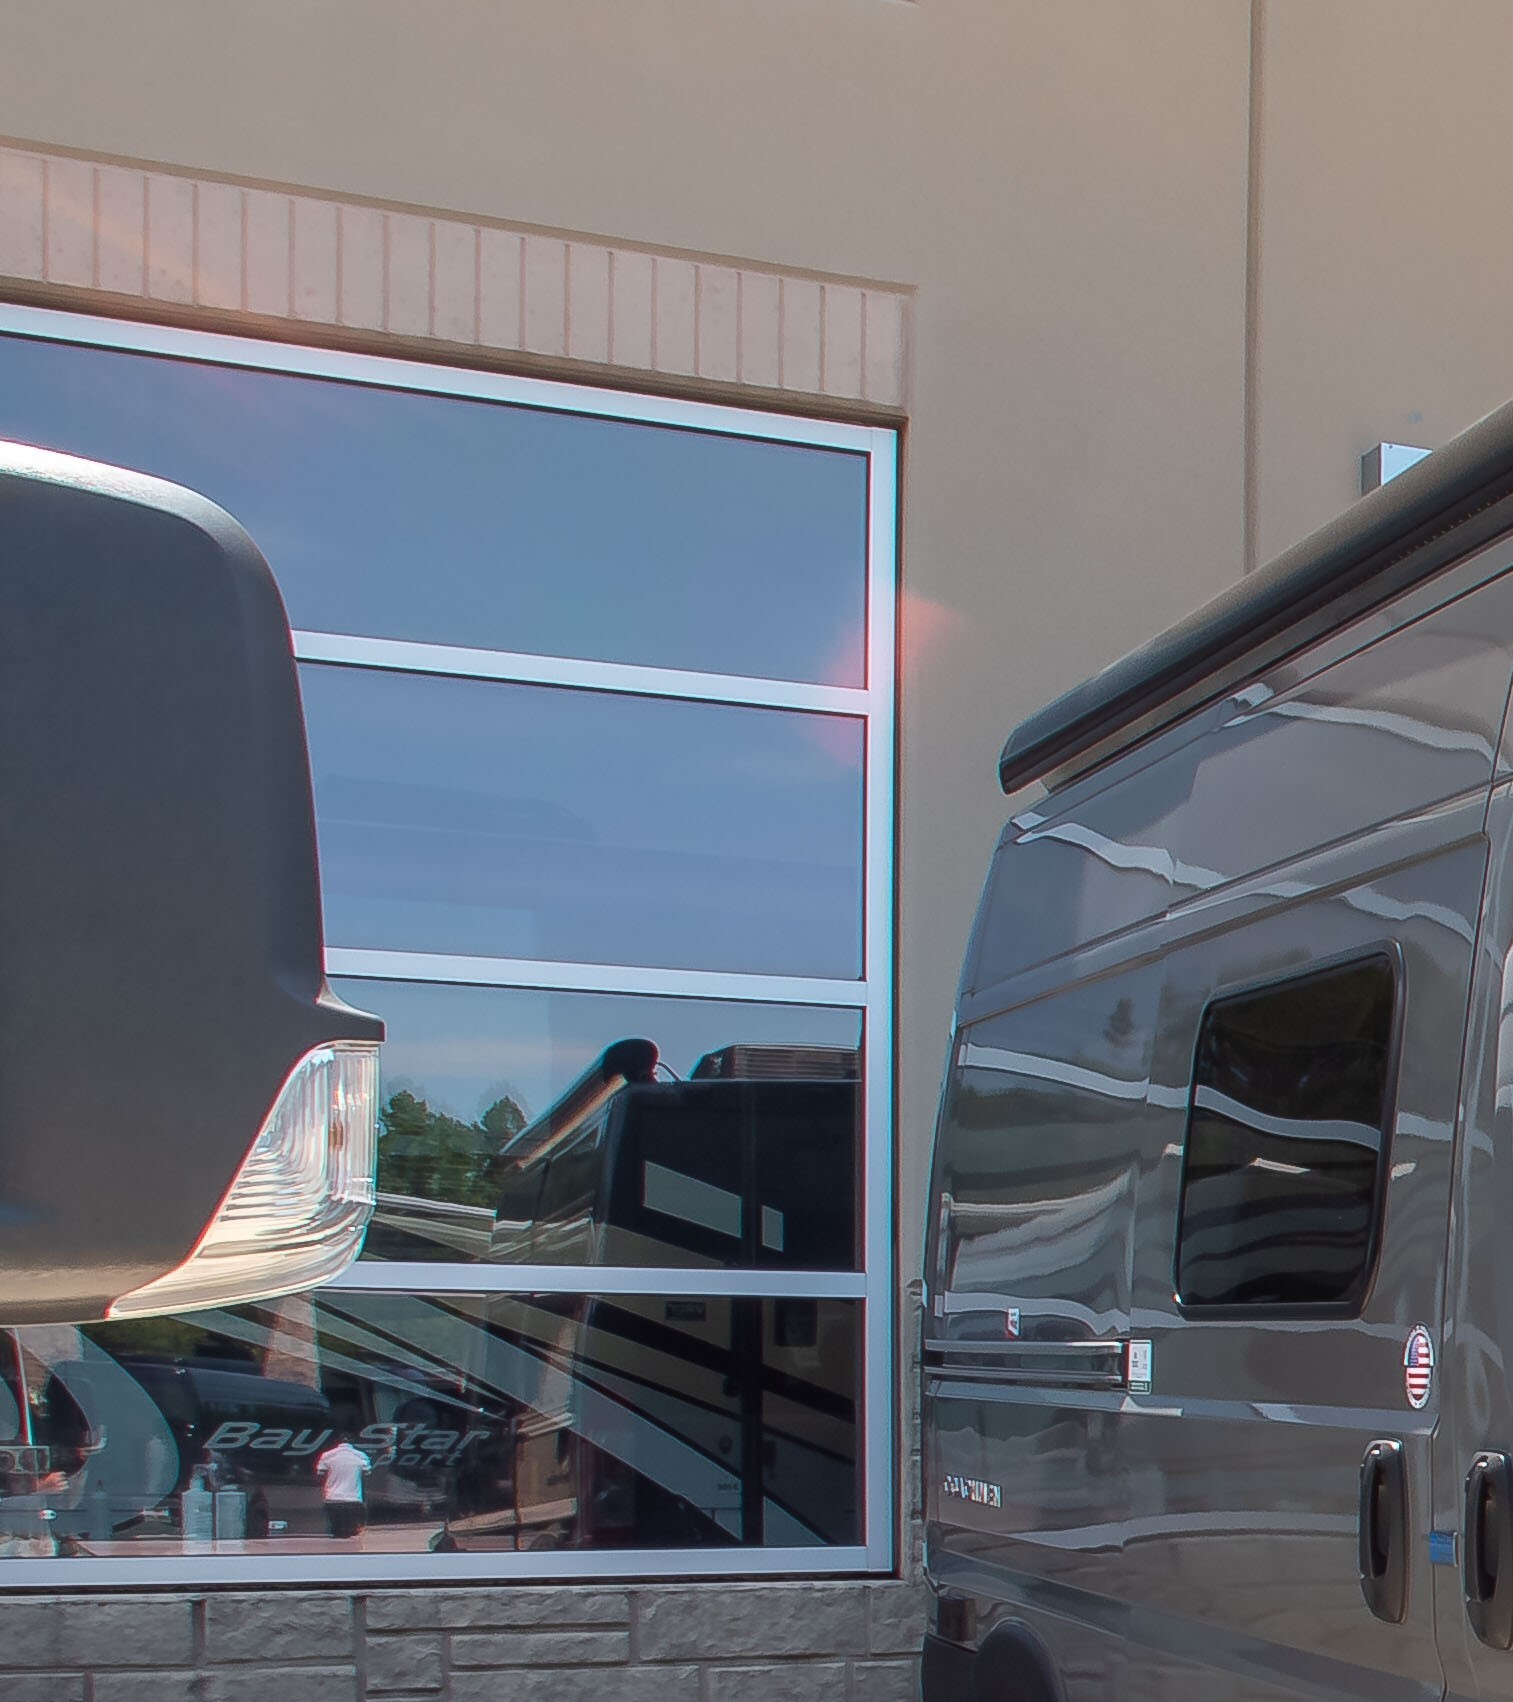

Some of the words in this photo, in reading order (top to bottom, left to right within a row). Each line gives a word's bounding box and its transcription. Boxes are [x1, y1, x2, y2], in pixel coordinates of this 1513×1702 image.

[202, 1421, 334, 1456] Bay
[355, 1421, 492, 1451] Star
[373, 1449, 463, 1468] port
